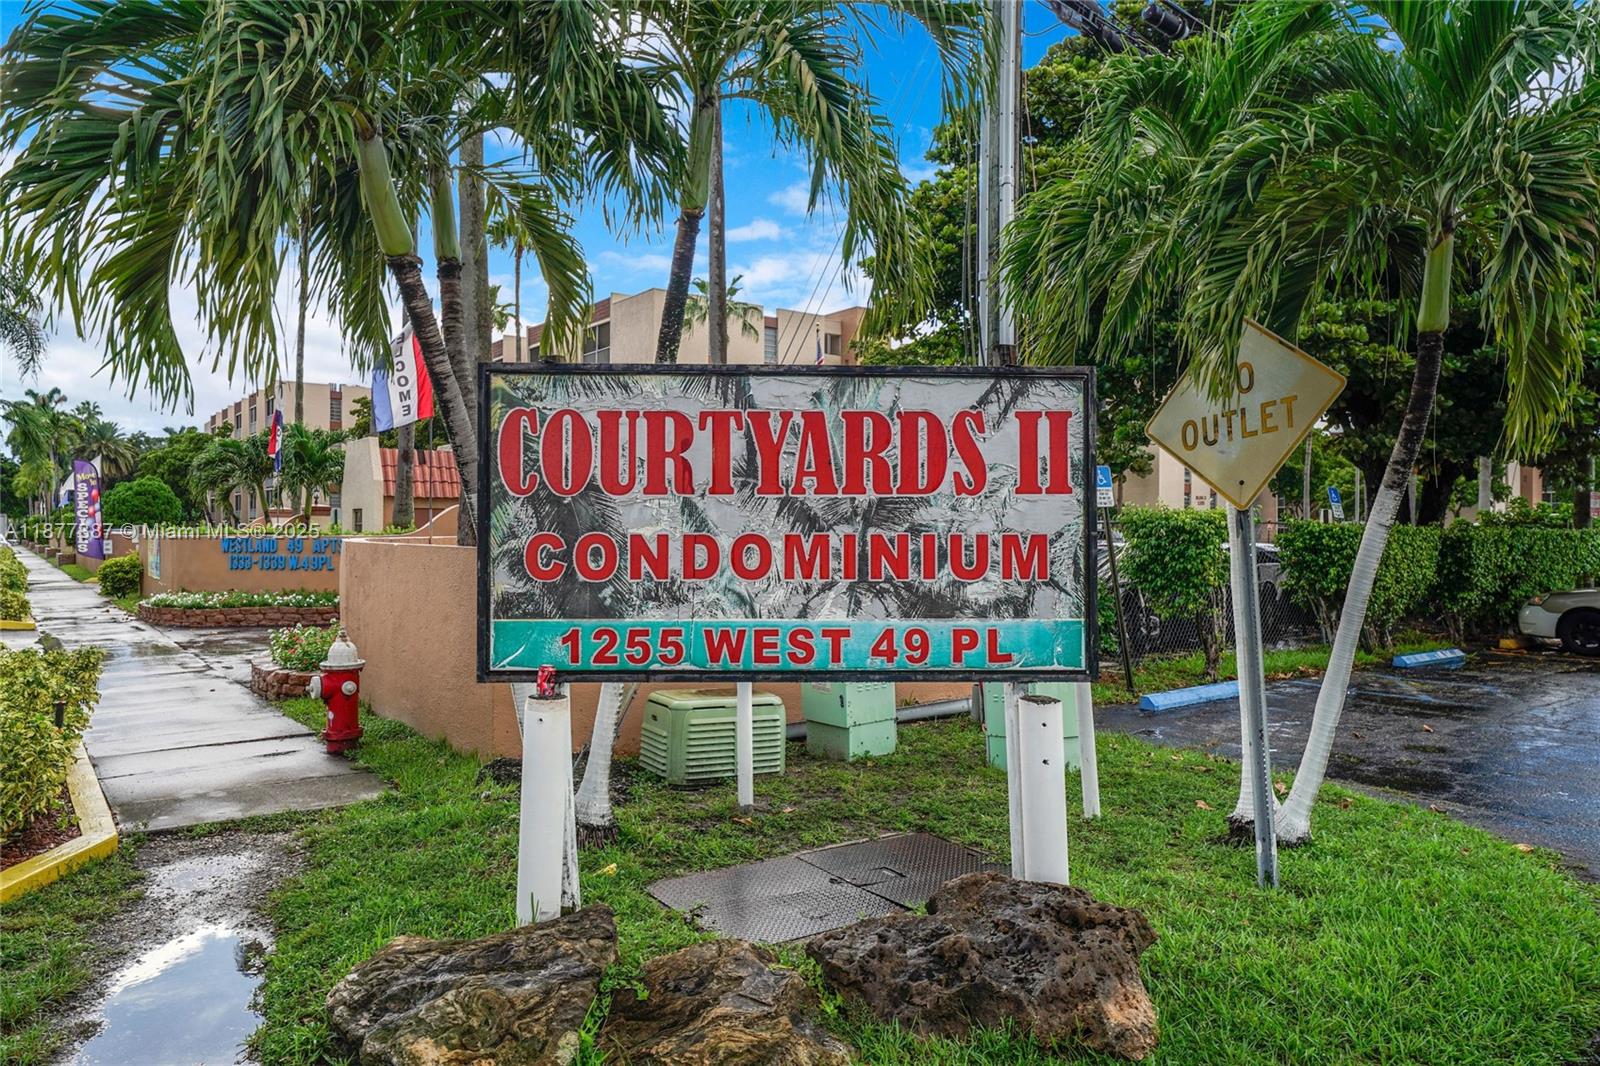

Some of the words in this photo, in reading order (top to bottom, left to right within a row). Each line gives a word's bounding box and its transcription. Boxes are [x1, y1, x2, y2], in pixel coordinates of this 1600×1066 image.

[1181, 395, 1298, 451] OUTLET
[498, 407, 988, 497] COURTYARDS
[1014, 410, 1073, 496] II
[221, 538, 278, 553] WESTLAND
[287, 539, 303, 553] 49
[524, 532, 1050, 582] CONDOMINIUM
[561, 627, 685, 666] 1255
[702, 627, 851, 666] WEST
[869, 627, 931, 666] 49
[951, 627, 1014, 665] PL
